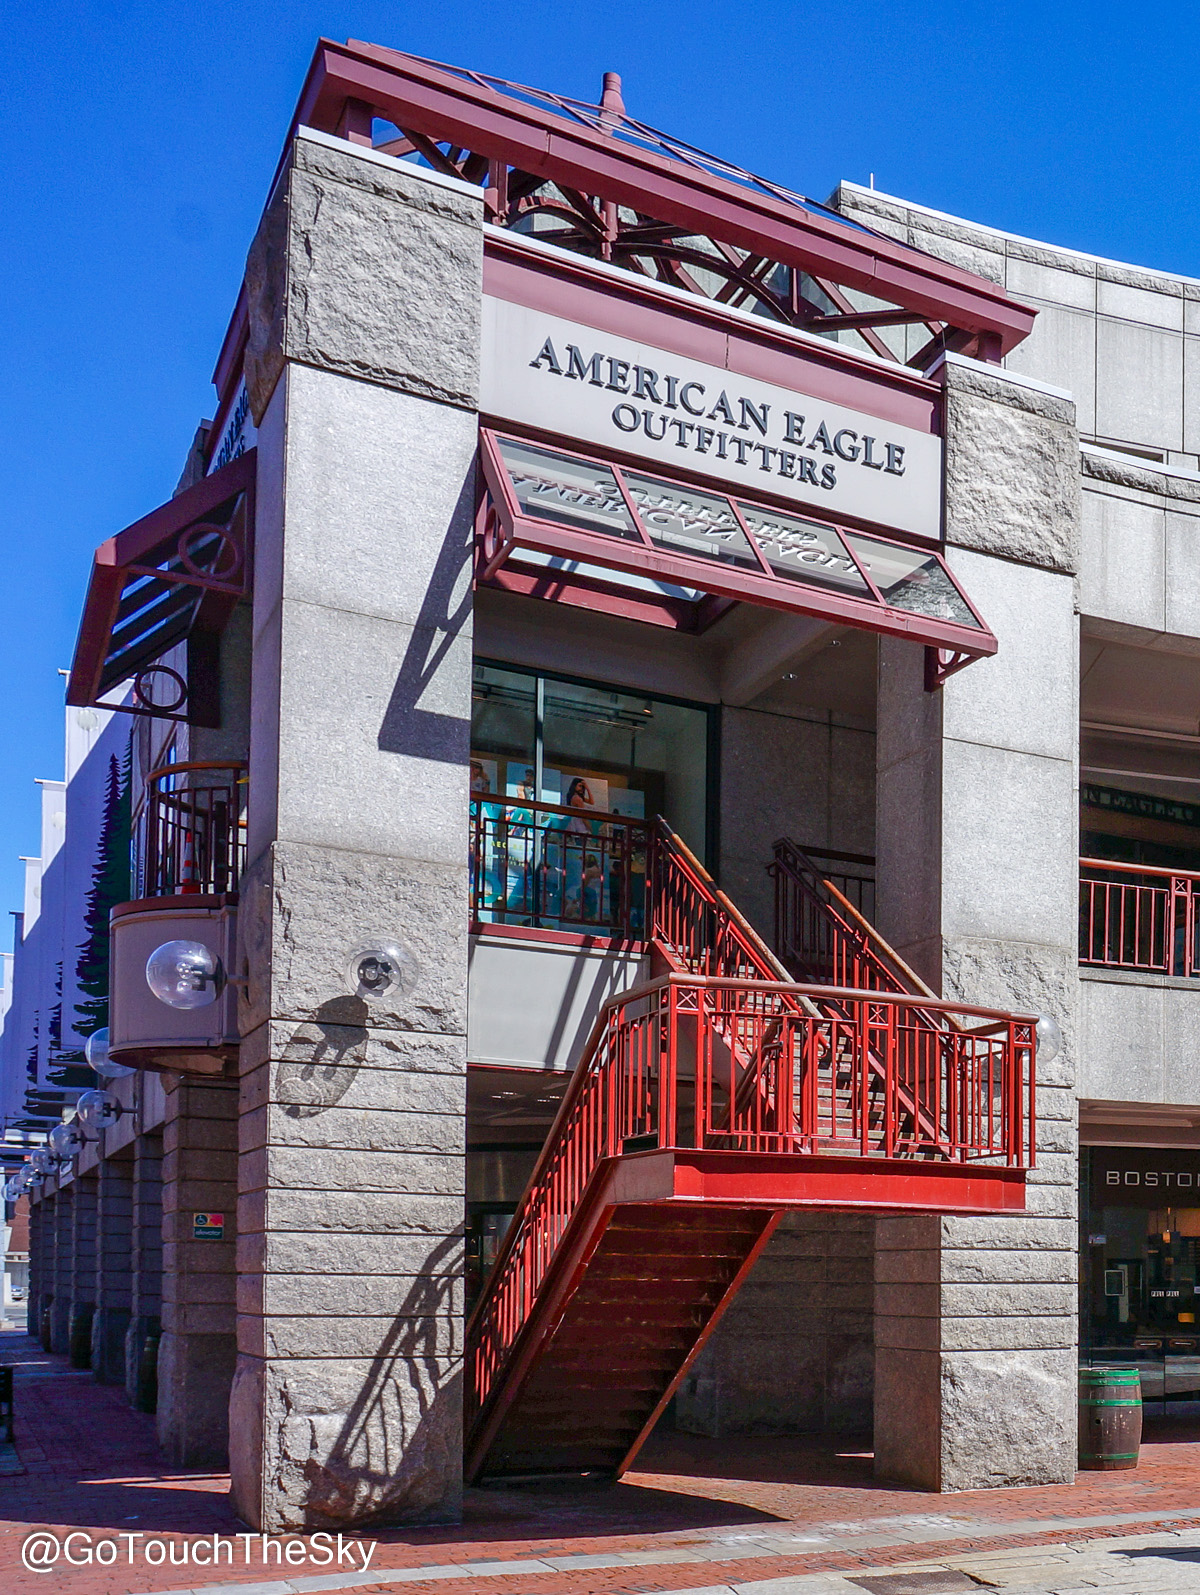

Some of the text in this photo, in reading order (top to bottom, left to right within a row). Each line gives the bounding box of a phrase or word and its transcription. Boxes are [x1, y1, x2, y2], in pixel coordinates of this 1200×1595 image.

[529, 336, 906, 477] AMERICAN EAGLE
[612, 402, 838, 490] OUTFITTERS
